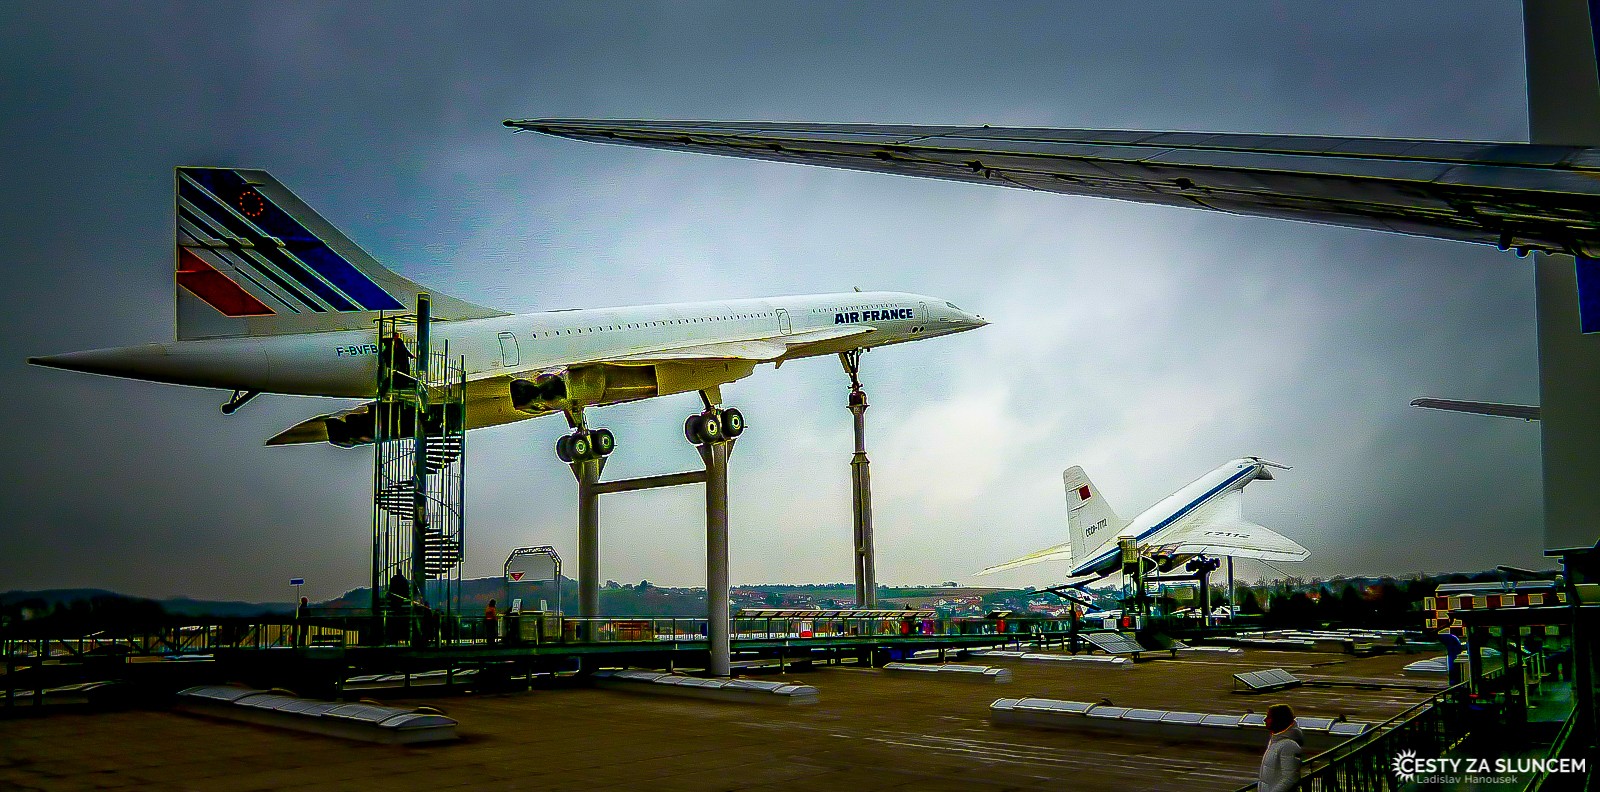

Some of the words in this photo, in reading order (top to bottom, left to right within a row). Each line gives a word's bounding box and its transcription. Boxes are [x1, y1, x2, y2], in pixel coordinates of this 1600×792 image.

[834, 312, 860, 324] AIR
[862, 308, 914, 322] FRANCE
[336, 344, 378, 357] F-BVFB
